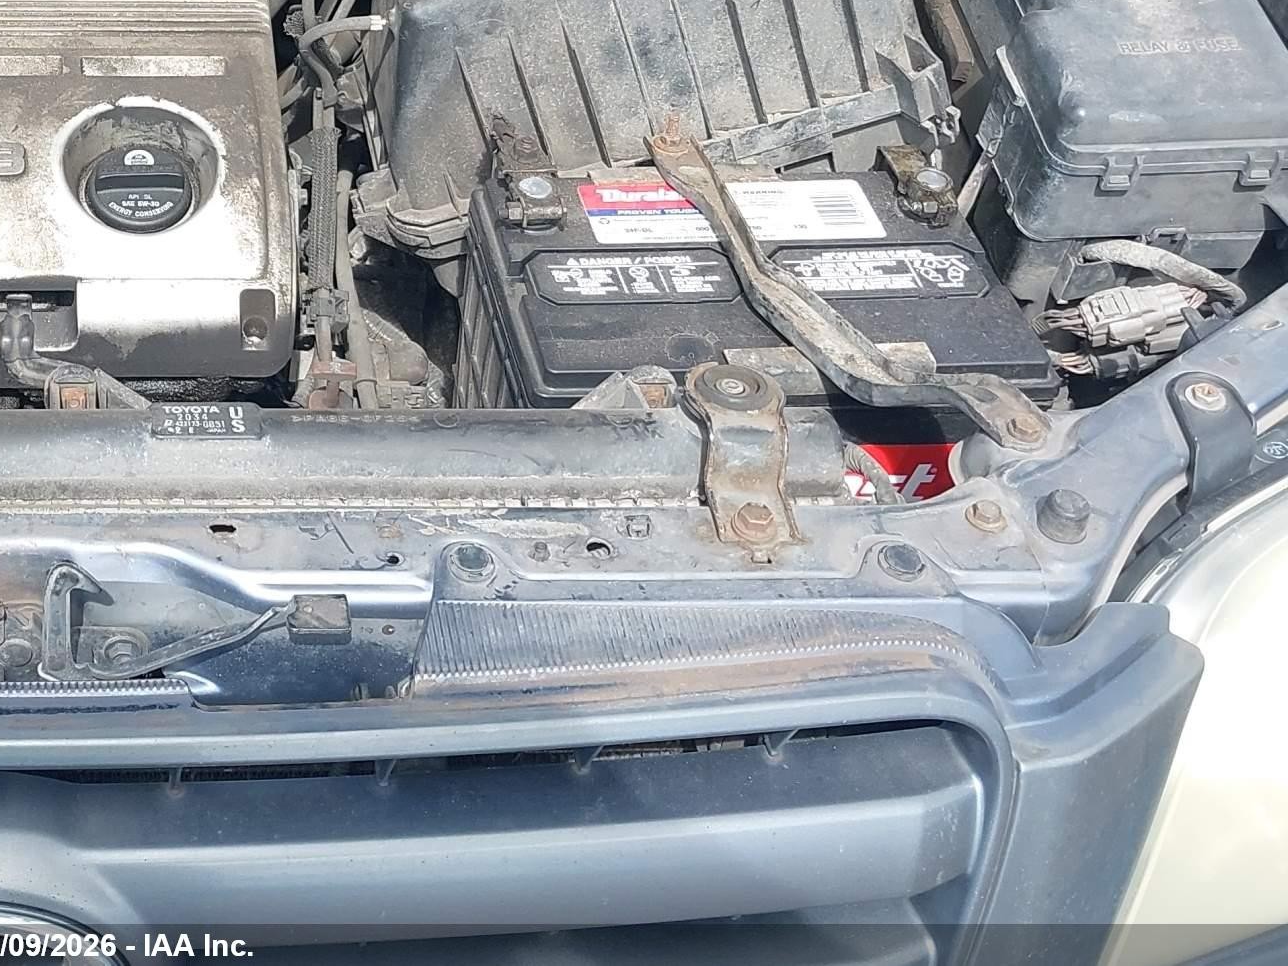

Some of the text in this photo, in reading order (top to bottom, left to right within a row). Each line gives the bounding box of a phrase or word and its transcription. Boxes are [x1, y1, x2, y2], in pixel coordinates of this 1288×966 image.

[1117, 36, 1242, 55] RELAY & FUSE
[595, 186, 687, 203] Durala
[579, 257, 632, 266] DANGER
[643, 255, 692, 264] POISON
[162, 405, 220, 414] TOYOTA
